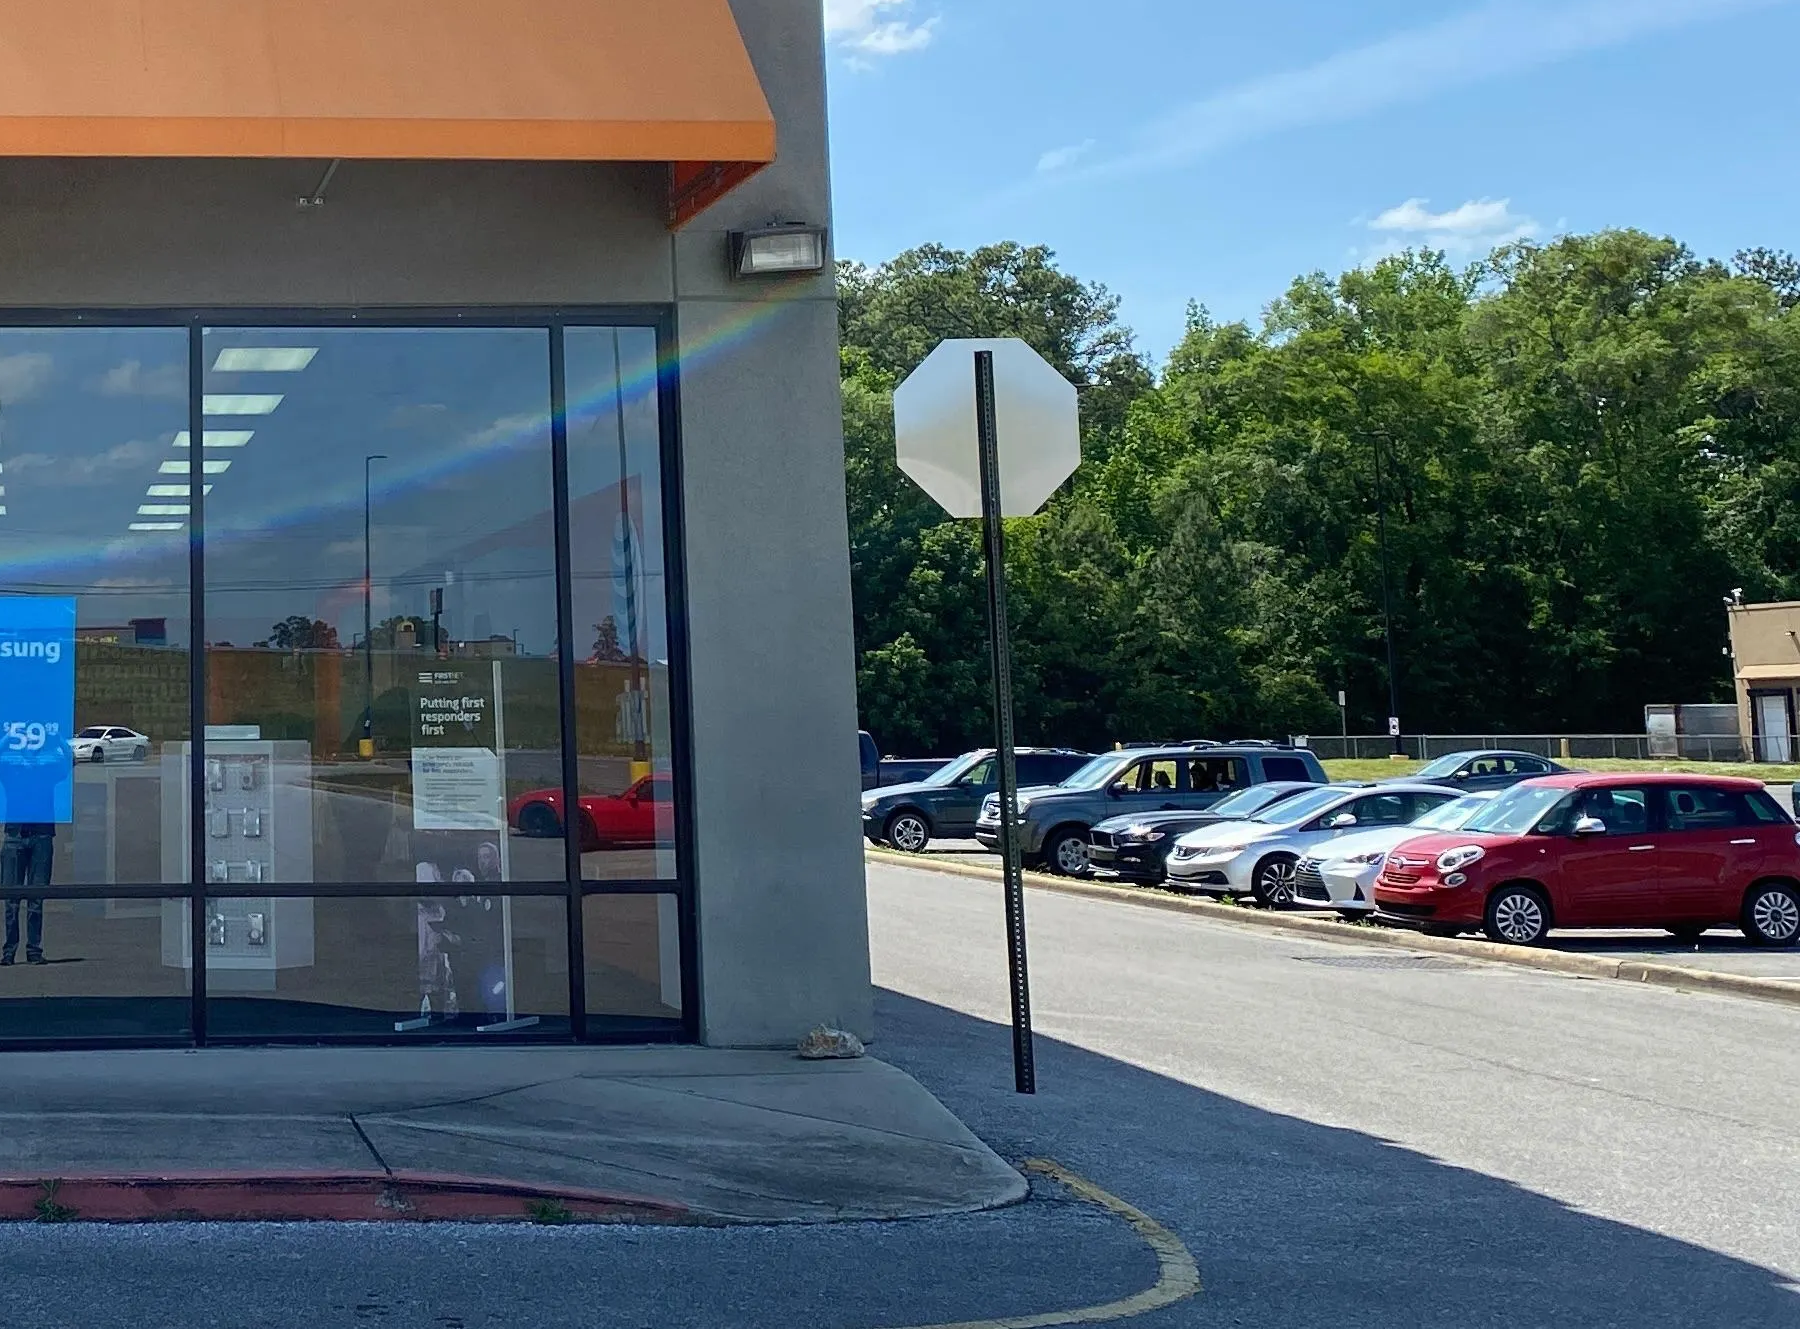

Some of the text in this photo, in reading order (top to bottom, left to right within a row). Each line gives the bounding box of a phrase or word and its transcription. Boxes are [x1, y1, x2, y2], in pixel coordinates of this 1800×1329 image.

[420, 696, 485, 711] Putting first
[421, 710, 481, 724] responders
[421, 724, 445, 736] first
